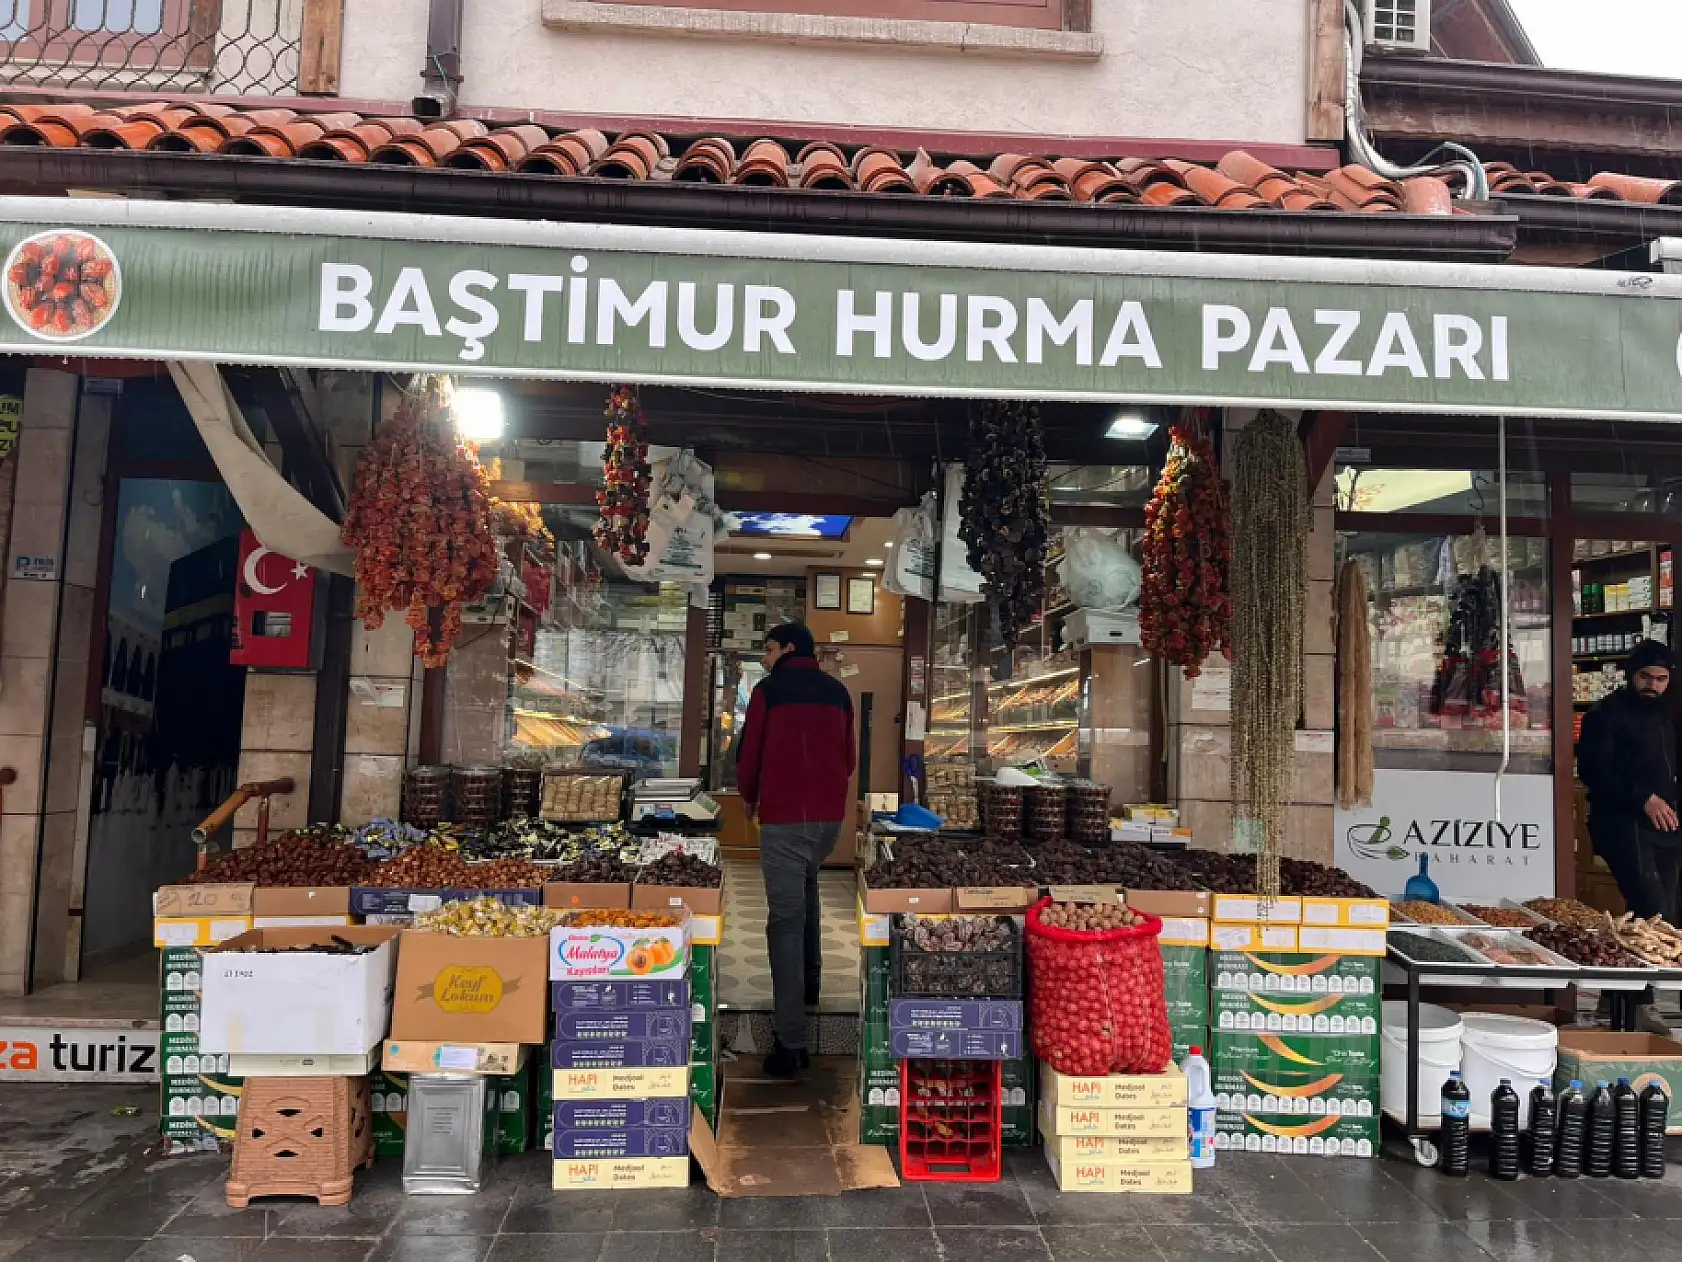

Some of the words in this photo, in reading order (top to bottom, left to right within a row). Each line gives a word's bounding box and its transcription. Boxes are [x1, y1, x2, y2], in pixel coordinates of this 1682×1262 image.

[318, 256, 795, 360] BAŞTİMUR
[837, 290, 1161, 369] HURMA
[1202, 304, 1509, 382] PAZARI
[50, 1033, 156, 1073] turiz
[568, 1074, 597, 1086] HAPI
[1072, 1082, 1101, 1093] HAPI
[1070, 1112, 1100, 1123] HAPI
[1076, 1137, 1105, 1149] HAPI
[568, 1164, 599, 1176] HAPI
[1076, 1167, 1105, 1178] HAPI
